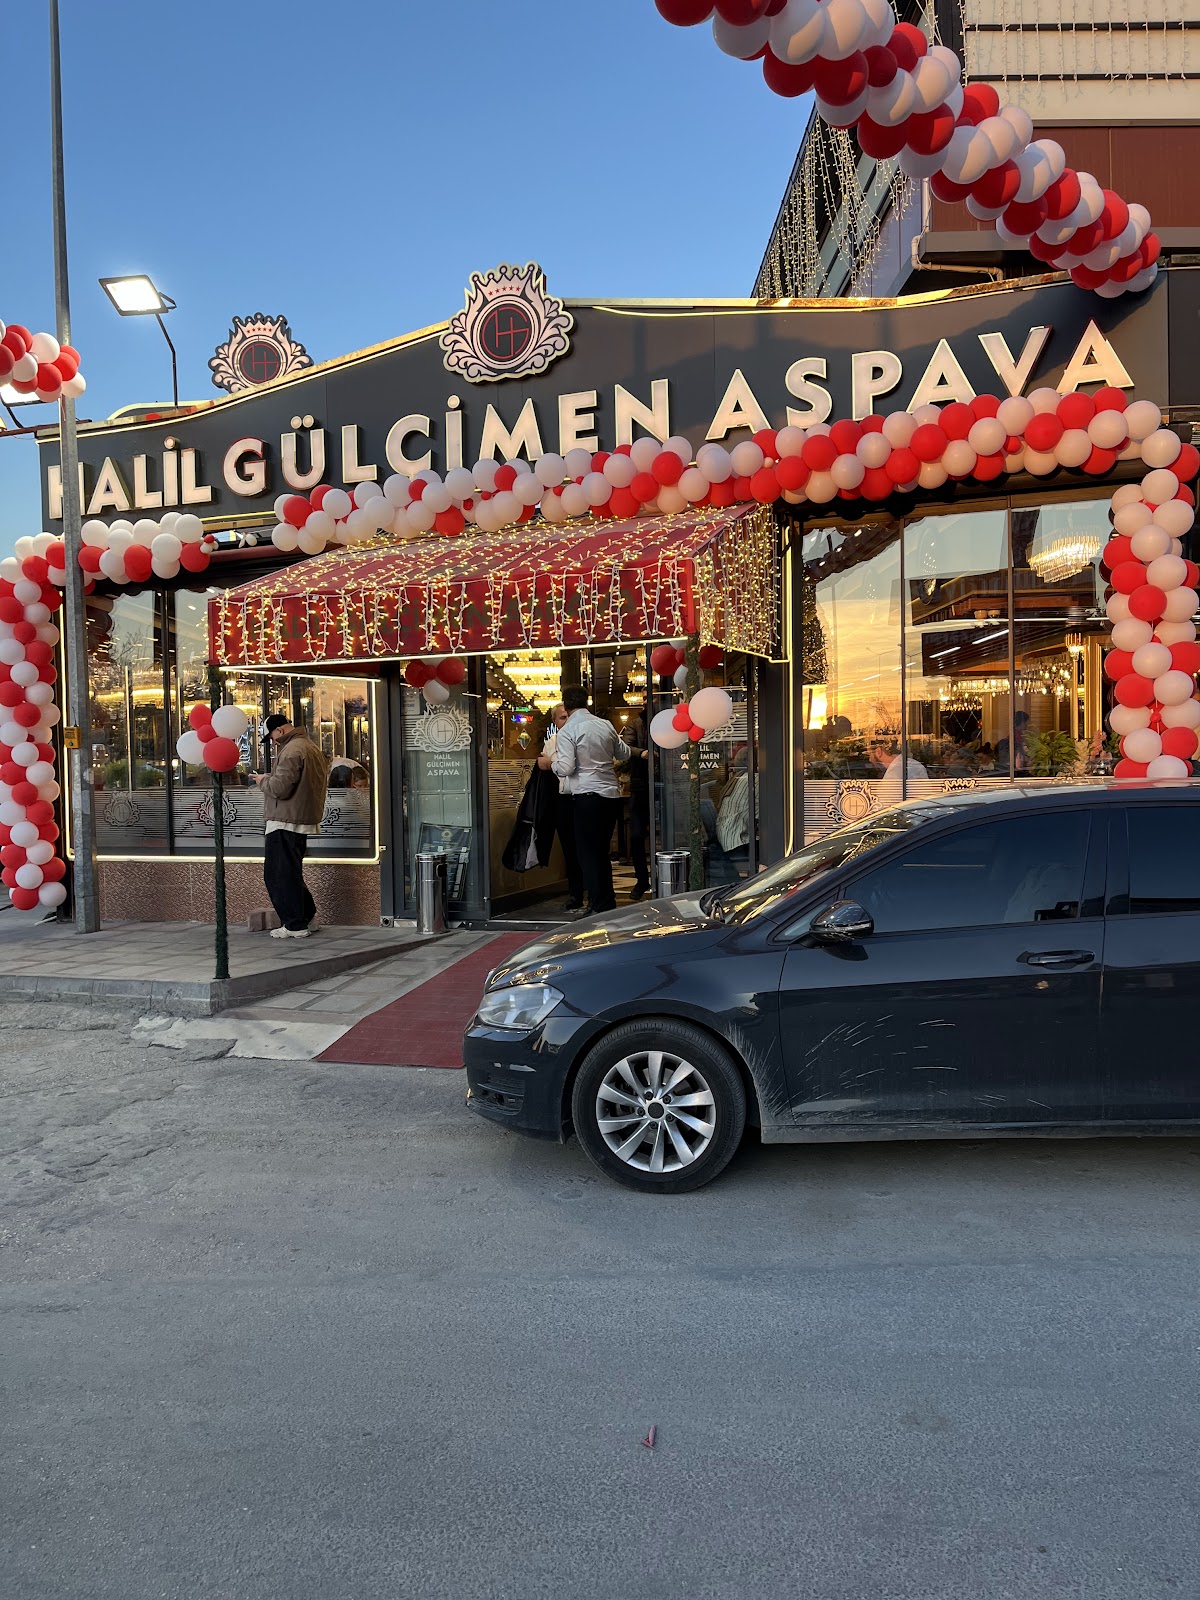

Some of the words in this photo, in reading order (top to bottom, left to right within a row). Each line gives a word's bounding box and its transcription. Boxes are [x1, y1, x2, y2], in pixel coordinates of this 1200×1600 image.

[47, 436, 213, 520] HALİL
[223, 378, 671, 498] GÜLÇİMEN
[704, 317, 1136, 441] ASPAVA
[433, 752, 452, 760] HALİL
[426, 760, 460, 769] GÜLÇİMEN
[426, 769, 460, 777] ASPAVA
